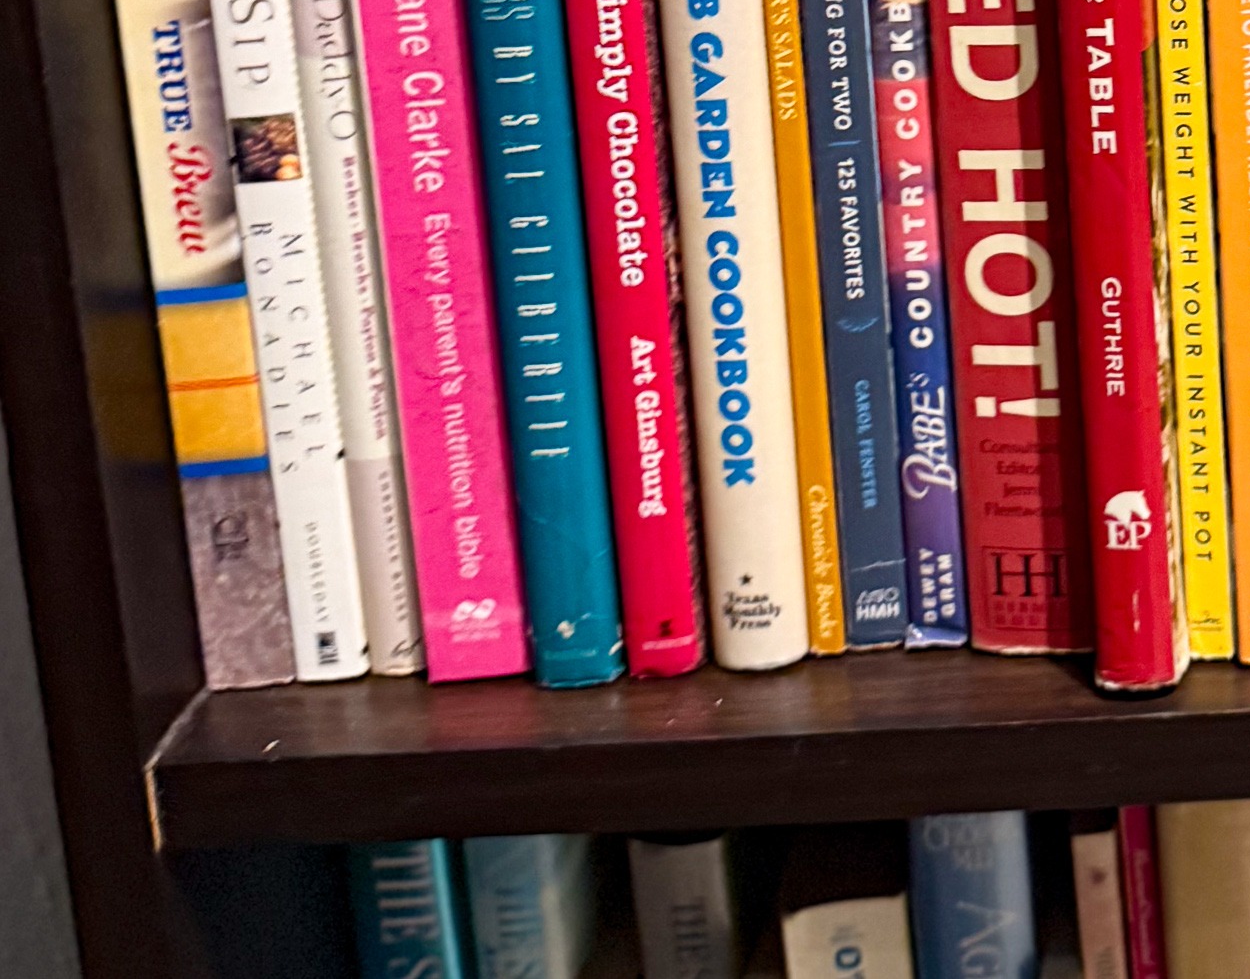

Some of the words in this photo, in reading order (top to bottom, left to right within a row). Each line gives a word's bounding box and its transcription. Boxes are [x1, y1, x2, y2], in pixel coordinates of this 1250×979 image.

[151, 21, 192, 134] TRUE
[772, 31, 799, 121] SALADS
[828, 26, 848, 70] FOR
[832, 76, 854, 131] TWO
[1084, 18, 1118, 157] TABLE
[402, 69, 454, 194] Clarke
[688, 30, 738, 219] GARDEN
[837, 157, 857, 191] 125
[1171, 67, 1195, 179] WEIGHT
[166, 141, 214, 259] Brew
[423, 211, 452, 286] Every
[609, 110, 649, 287] Chocolate
[840, 196, 866, 300] FAVORITES
[899, 157, 934, 350] COUNTRY
[1178, 195, 1199, 265] WITH
[957, 148, 1061, 420] HOT!
[1100, 276, 1127, 398] GUTHRIE
[1182, 281, 1201, 358] YOUR
[248, 221, 299, 475] BONADIES
[279, 232, 327, 460] MICHAEL
[427, 291, 468, 398] parent's
[629, 335, 656, 387] Art
[705, 229, 758, 489] COOKBOOK
[443, 401, 477, 511] nutrition
[637, 389, 669, 518] Ginsburg
[859, 433, 881, 509] FENSTER
[1187, 374, 1209, 495] INSTANT
[455, 515, 482, 581] bible
[1193, 511, 1213, 563] POT
